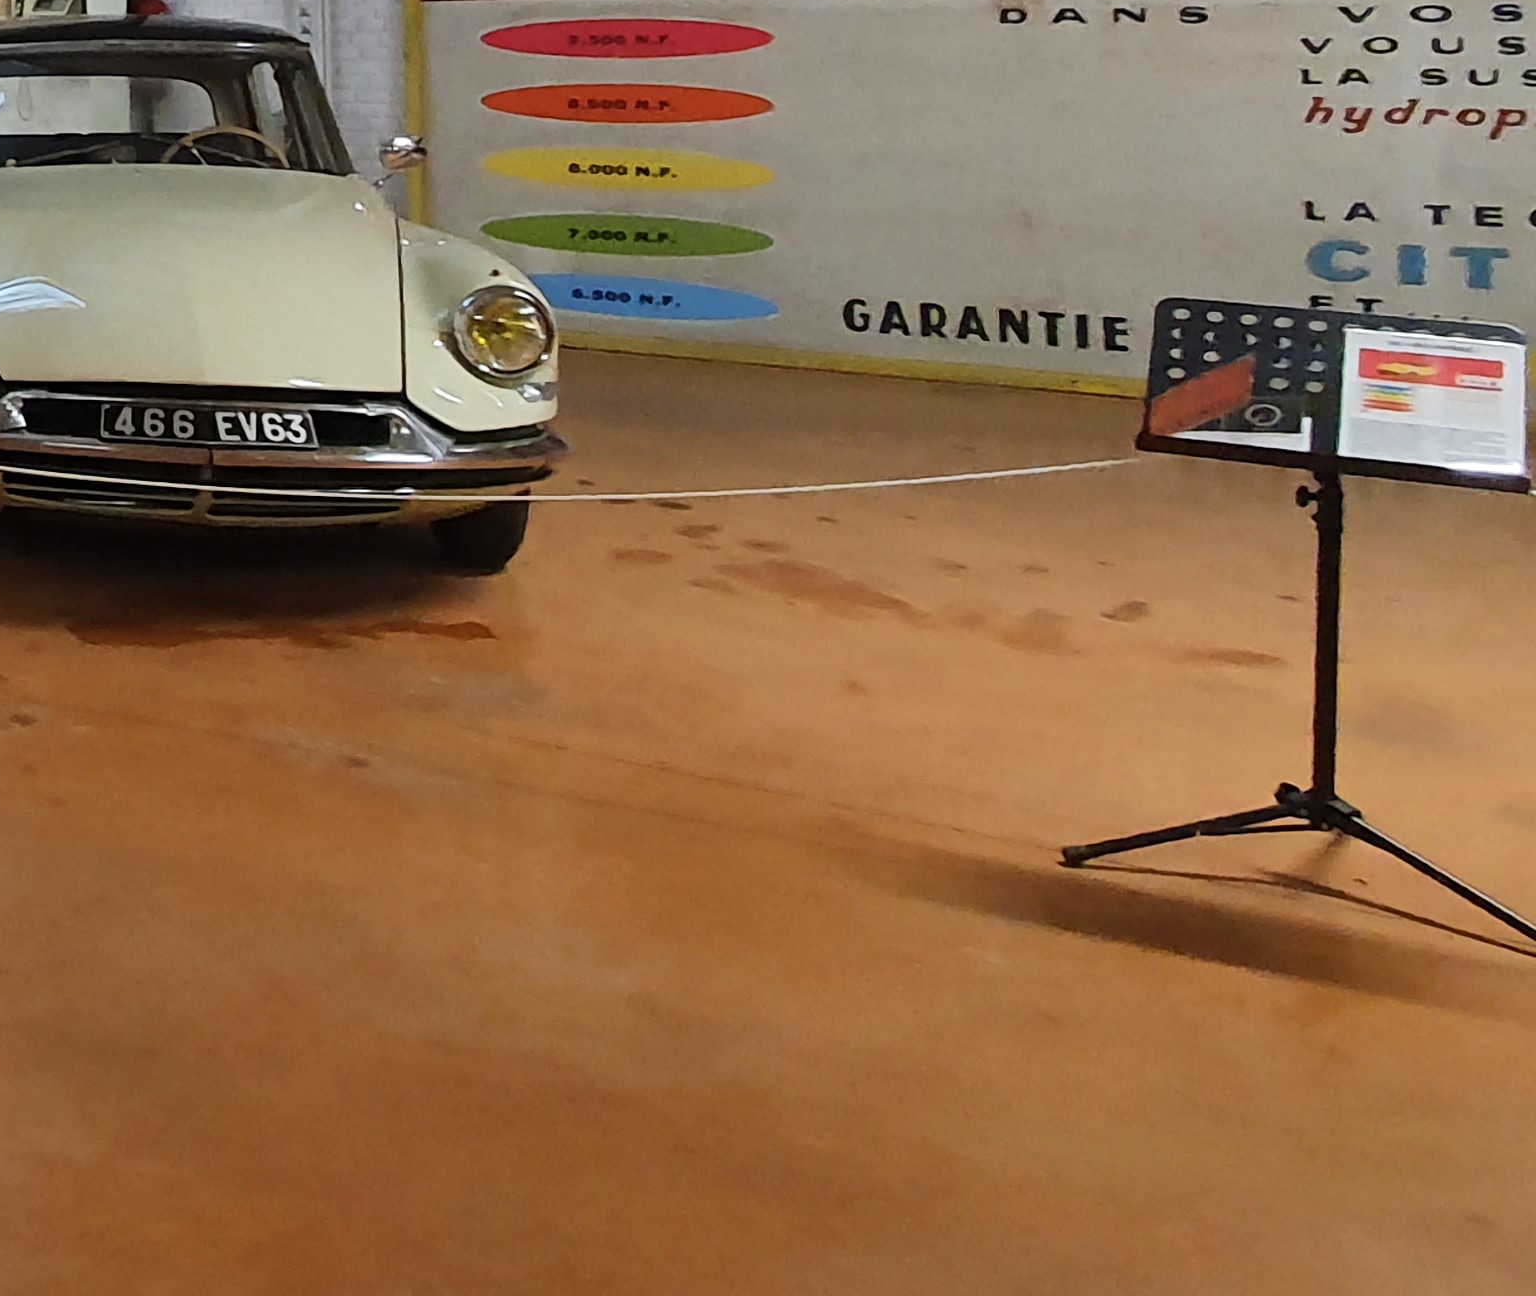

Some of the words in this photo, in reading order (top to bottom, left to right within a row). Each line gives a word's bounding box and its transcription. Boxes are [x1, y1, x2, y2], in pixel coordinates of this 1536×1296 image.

[999, 6, 1210, 25] DANS
[1337, 4, 1524, 23] VOS
[1300, 36, 1527, 56] VOUS
[1300, 68, 1370, 86] LA
[1304, 97, 1527, 140] hydrop
[1304, 200, 1378, 222] LA
[1423, 203, 1536, 227] TE
[1305, 239, 1512, 290] CIT
[842, 298, 1130, 352] GARANTIE
[114, 406, 195, 439] 466
